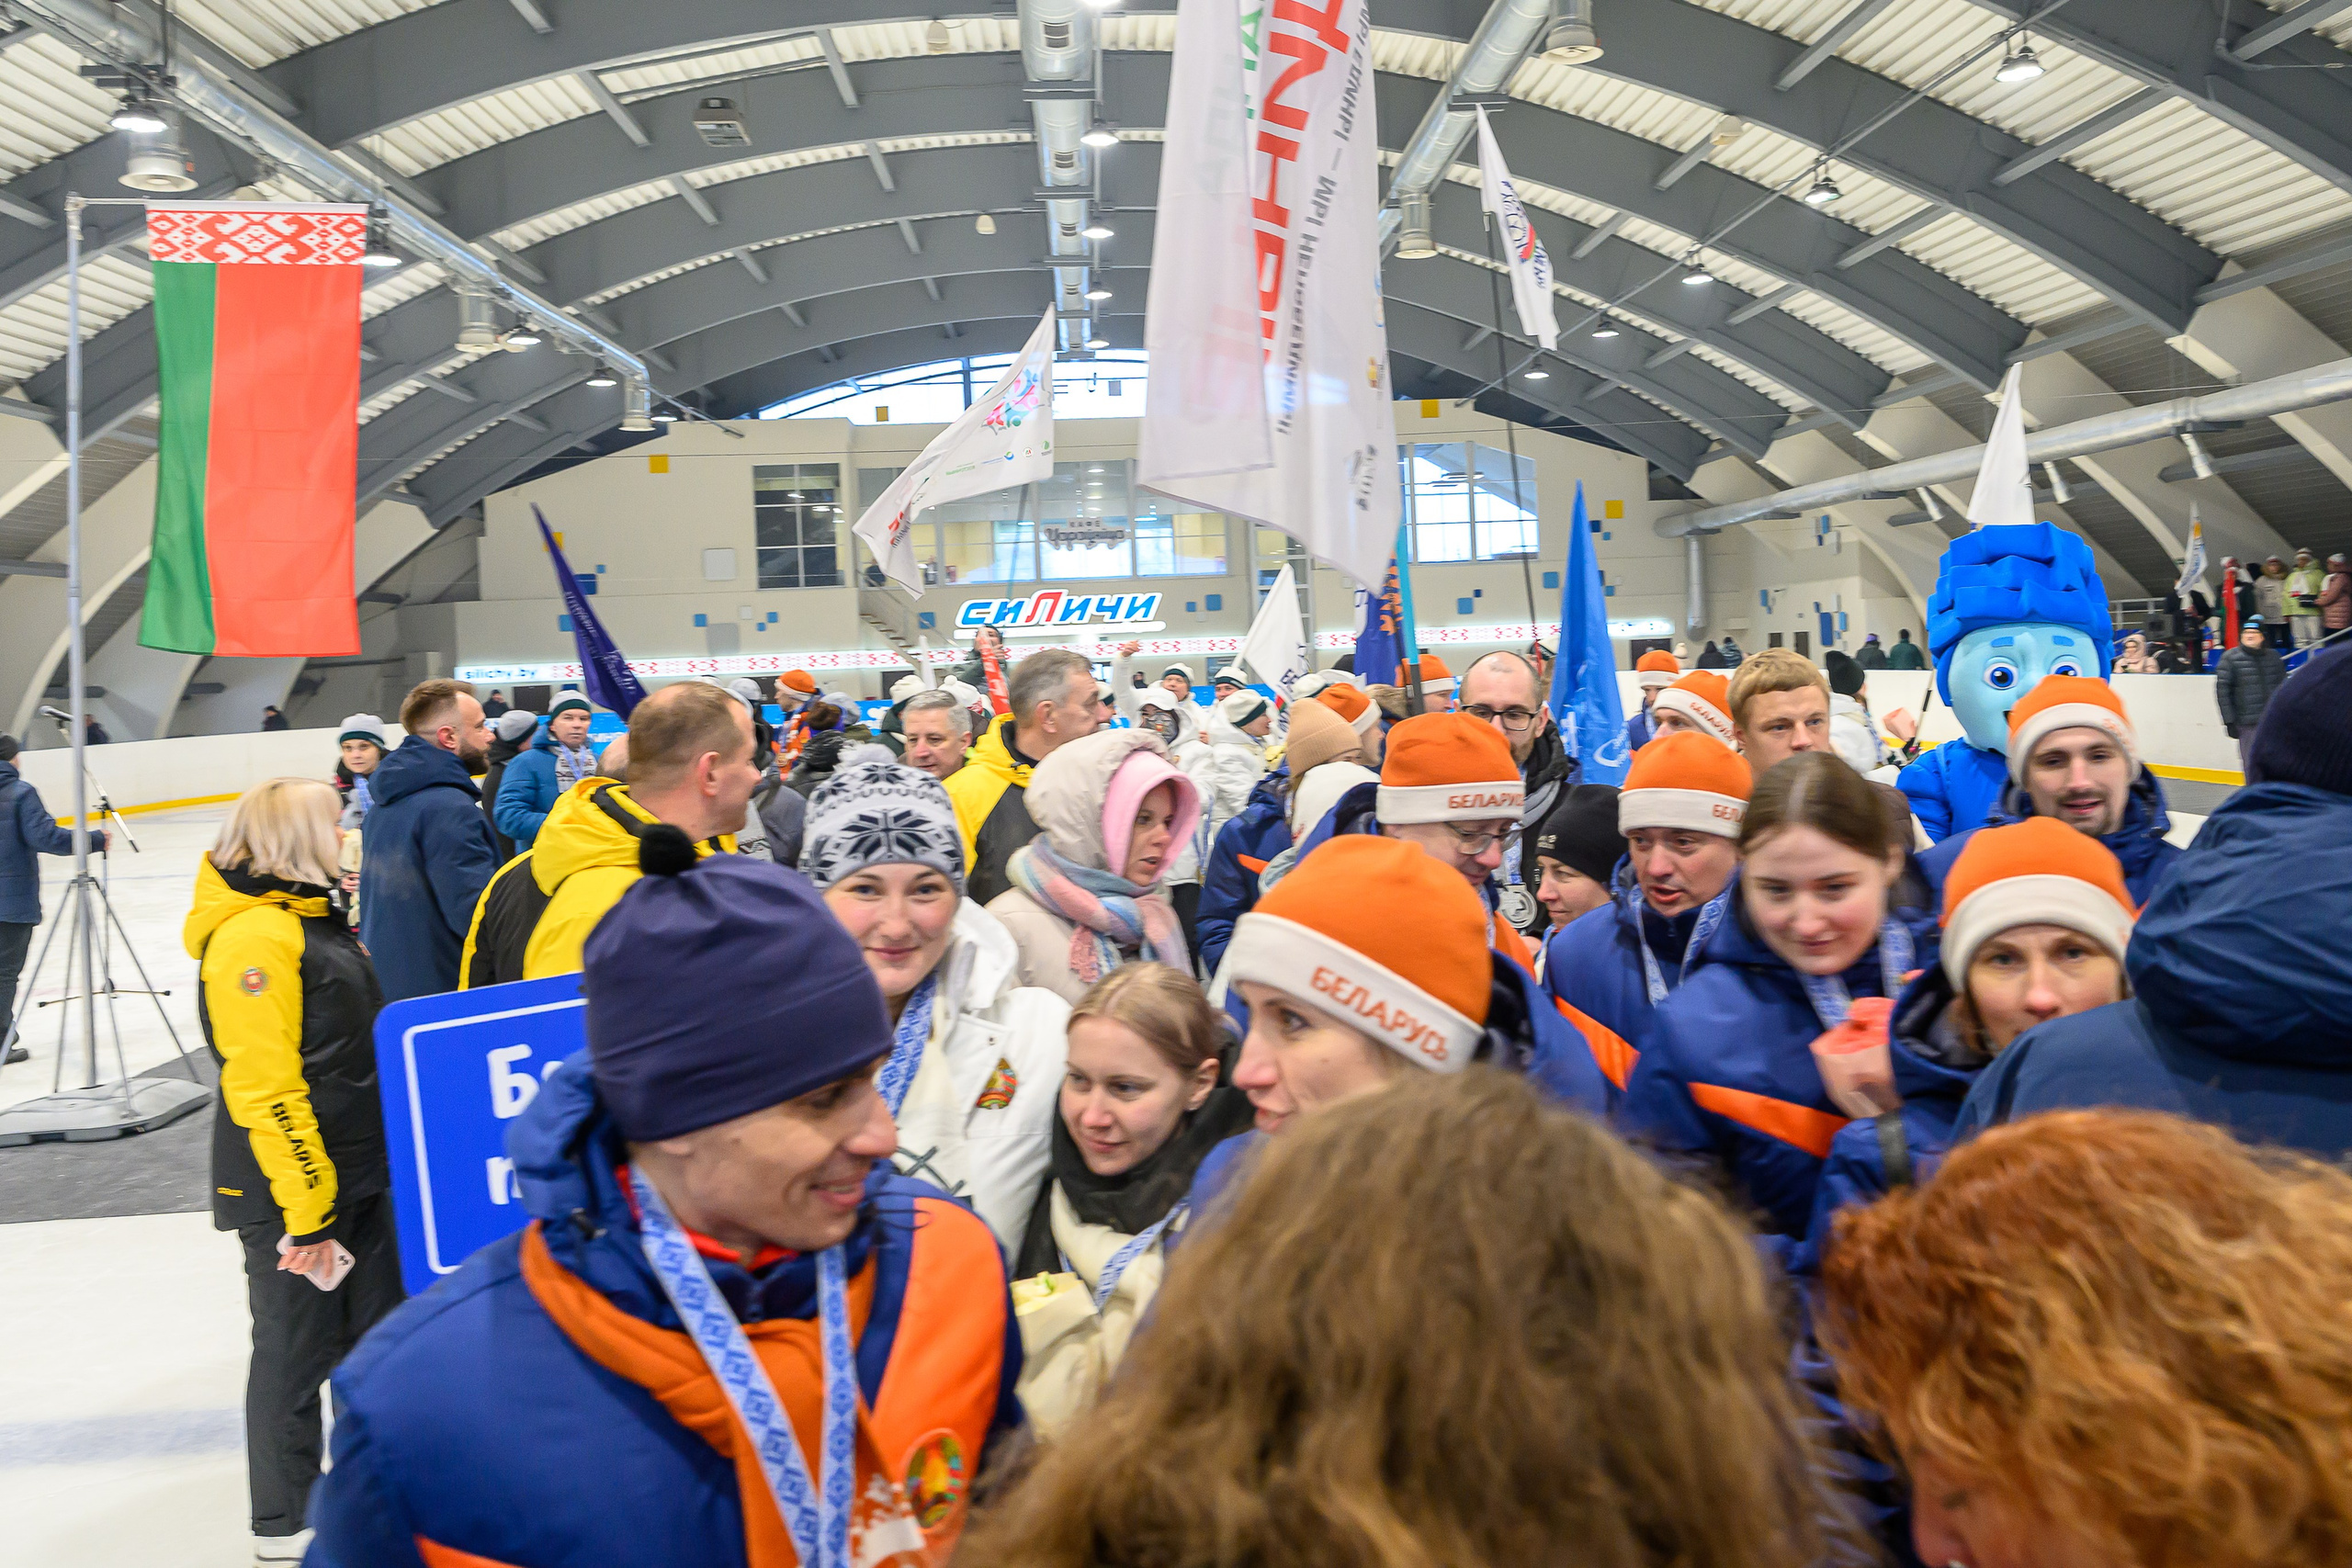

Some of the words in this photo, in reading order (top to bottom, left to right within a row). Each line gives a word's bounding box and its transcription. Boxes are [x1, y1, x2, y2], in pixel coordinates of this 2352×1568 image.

[1448, 792, 1524, 808] БЕЛАРУС
[1310, 965, 1450, 1061] БЕЛАРУСЬ
[271, 1101, 322, 1190] BELARUS
